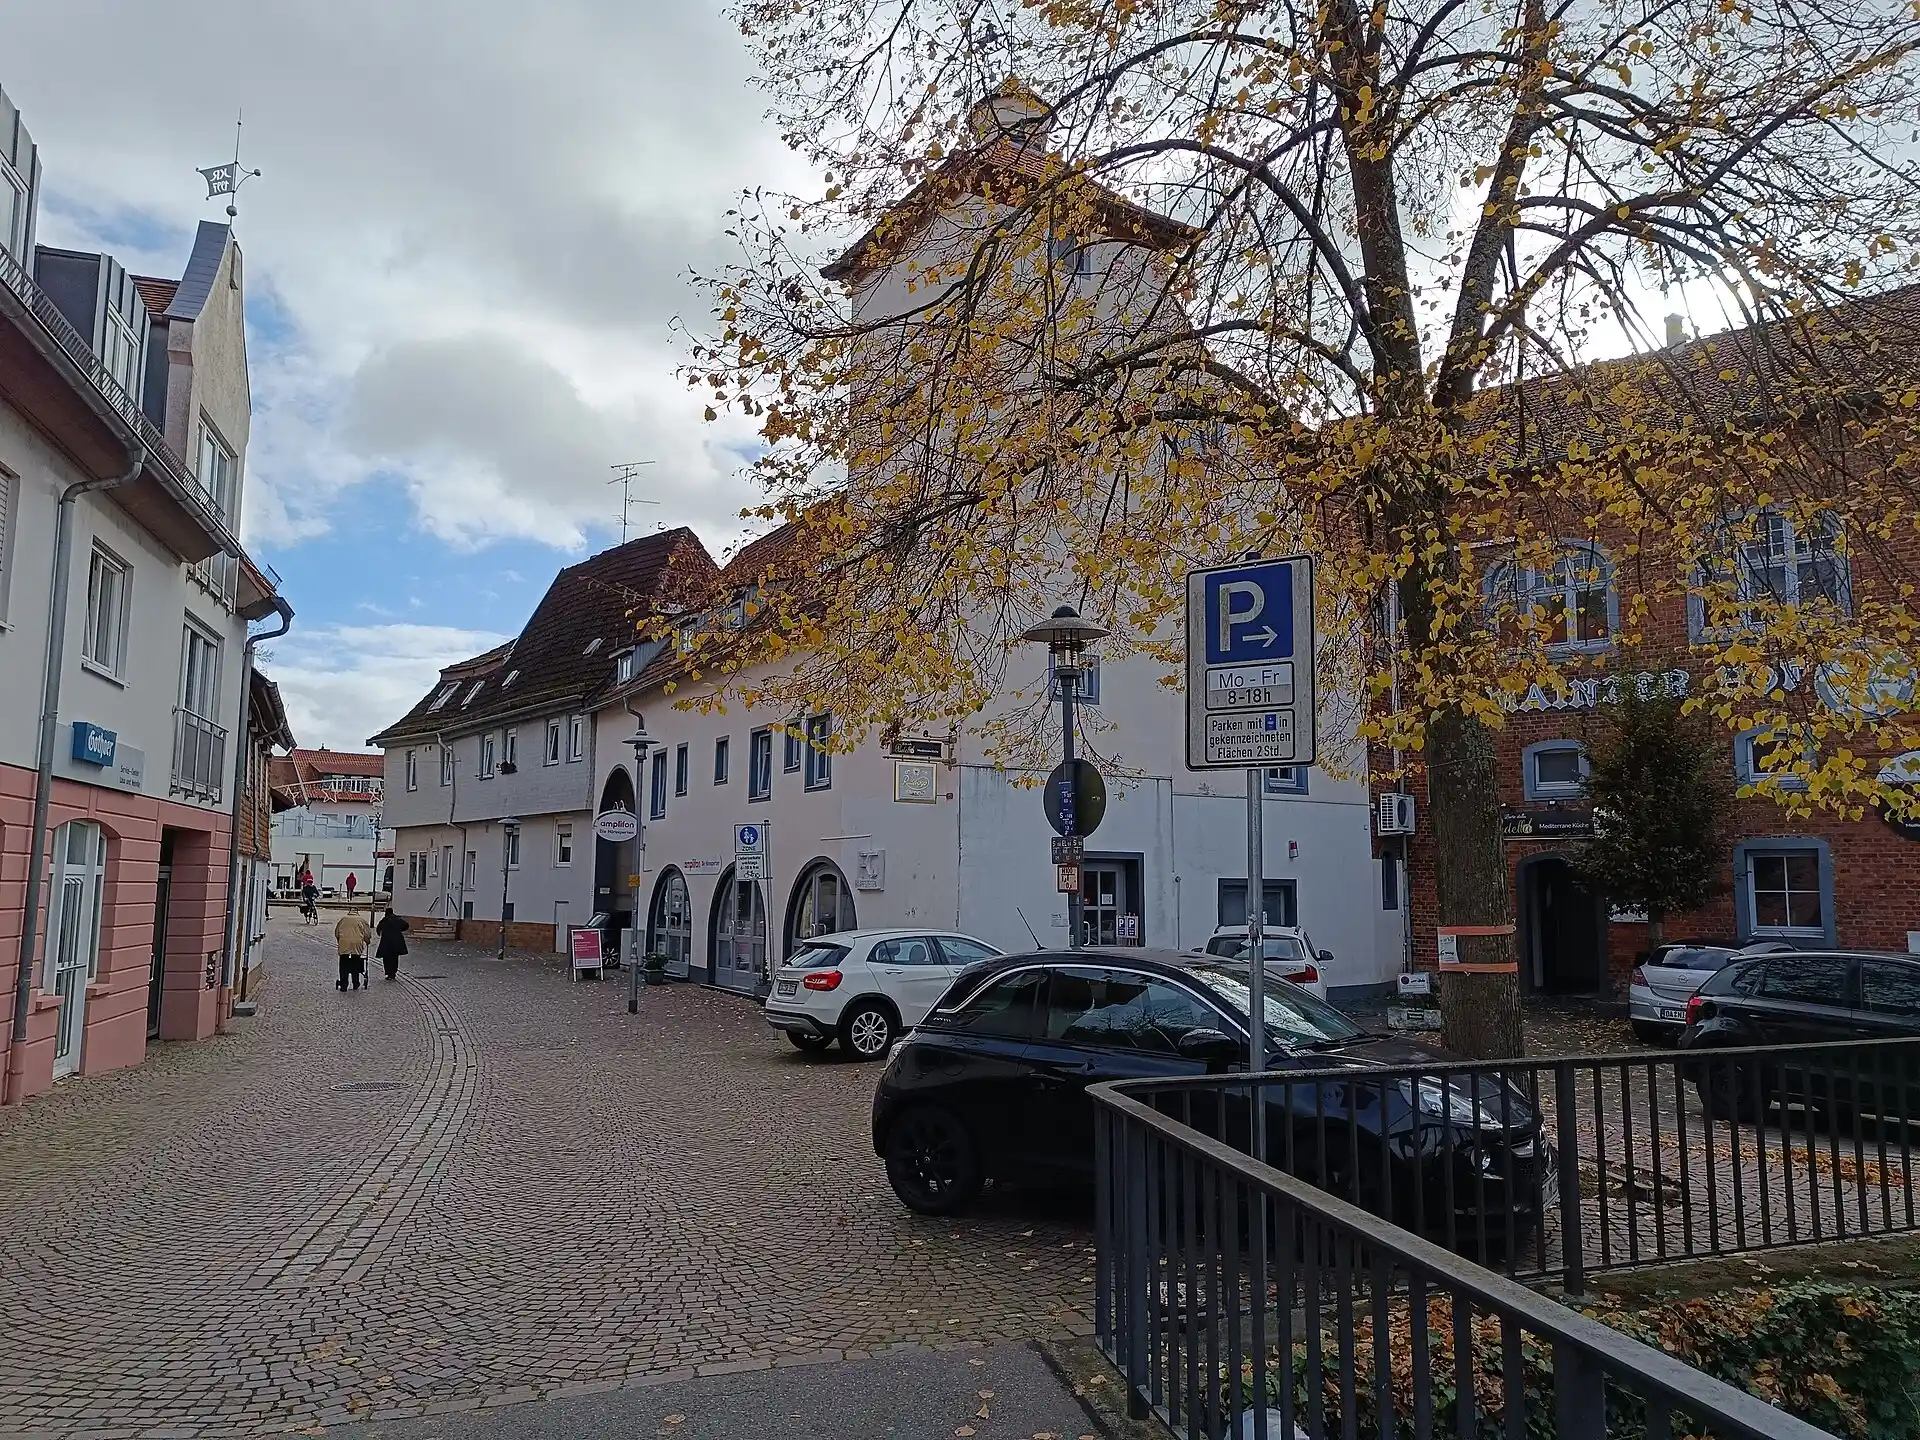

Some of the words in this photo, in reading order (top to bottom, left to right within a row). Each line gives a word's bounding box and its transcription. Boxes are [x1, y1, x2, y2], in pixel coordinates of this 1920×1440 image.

[1219, 580, 1265, 652] P
[1219, 673, 1244, 689] Mo
[1261, 669, 1280, 685] Fr
[1212, 719, 1243, 732] Parken
[1247, 717, 1263, 730] mit
[1279, 716, 1288, 728] in
[1209, 731, 1291, 748] gekennzeichneten
[1217, 745, 1253, 759] Flächen
[1256, 745, 1263, 757] 2
[1264, 743, 1282, 757] Std.
[600, 820, 635, 829] amplifon
[1503, 817, 1533, 834] della
